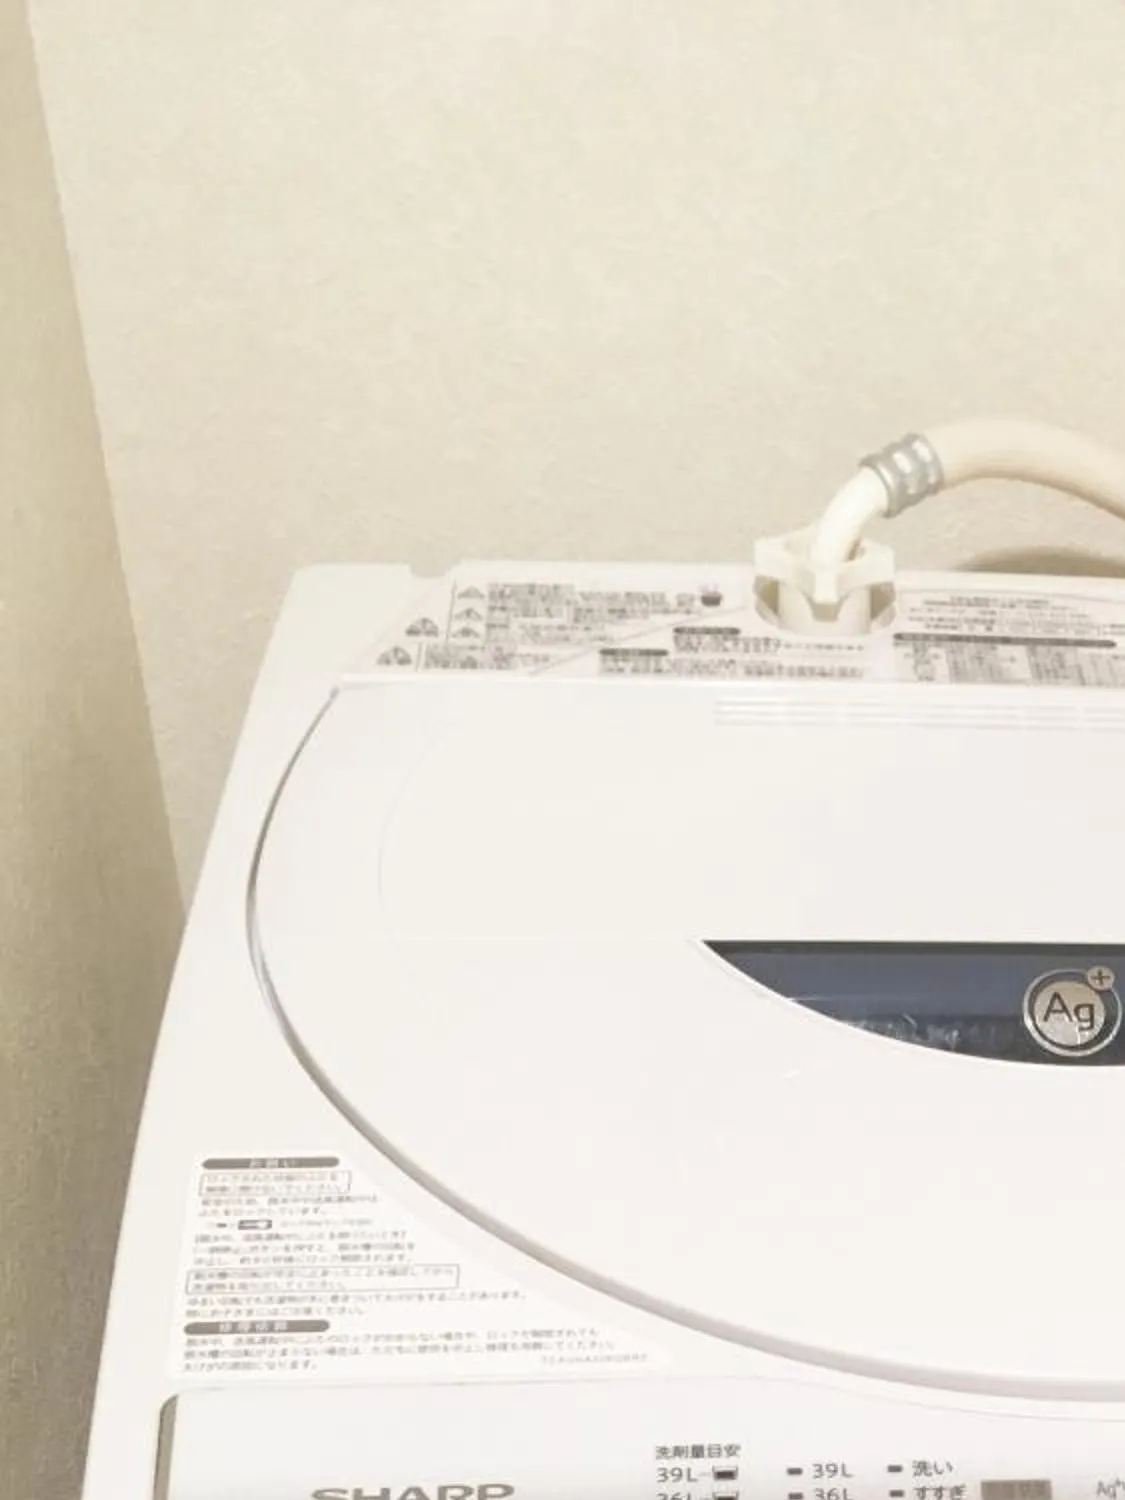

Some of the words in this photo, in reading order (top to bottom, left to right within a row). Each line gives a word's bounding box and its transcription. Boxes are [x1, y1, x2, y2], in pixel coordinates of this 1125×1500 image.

[655, 1444, 742, 1460] 洗剤量目安
[656, 1467, 699, 1482] 39L
[812, 1463, 854, 1478] 39L
[912, 1460, 953, 1477] 洗い
[914, 1484, 967, 1500] すすぎ
